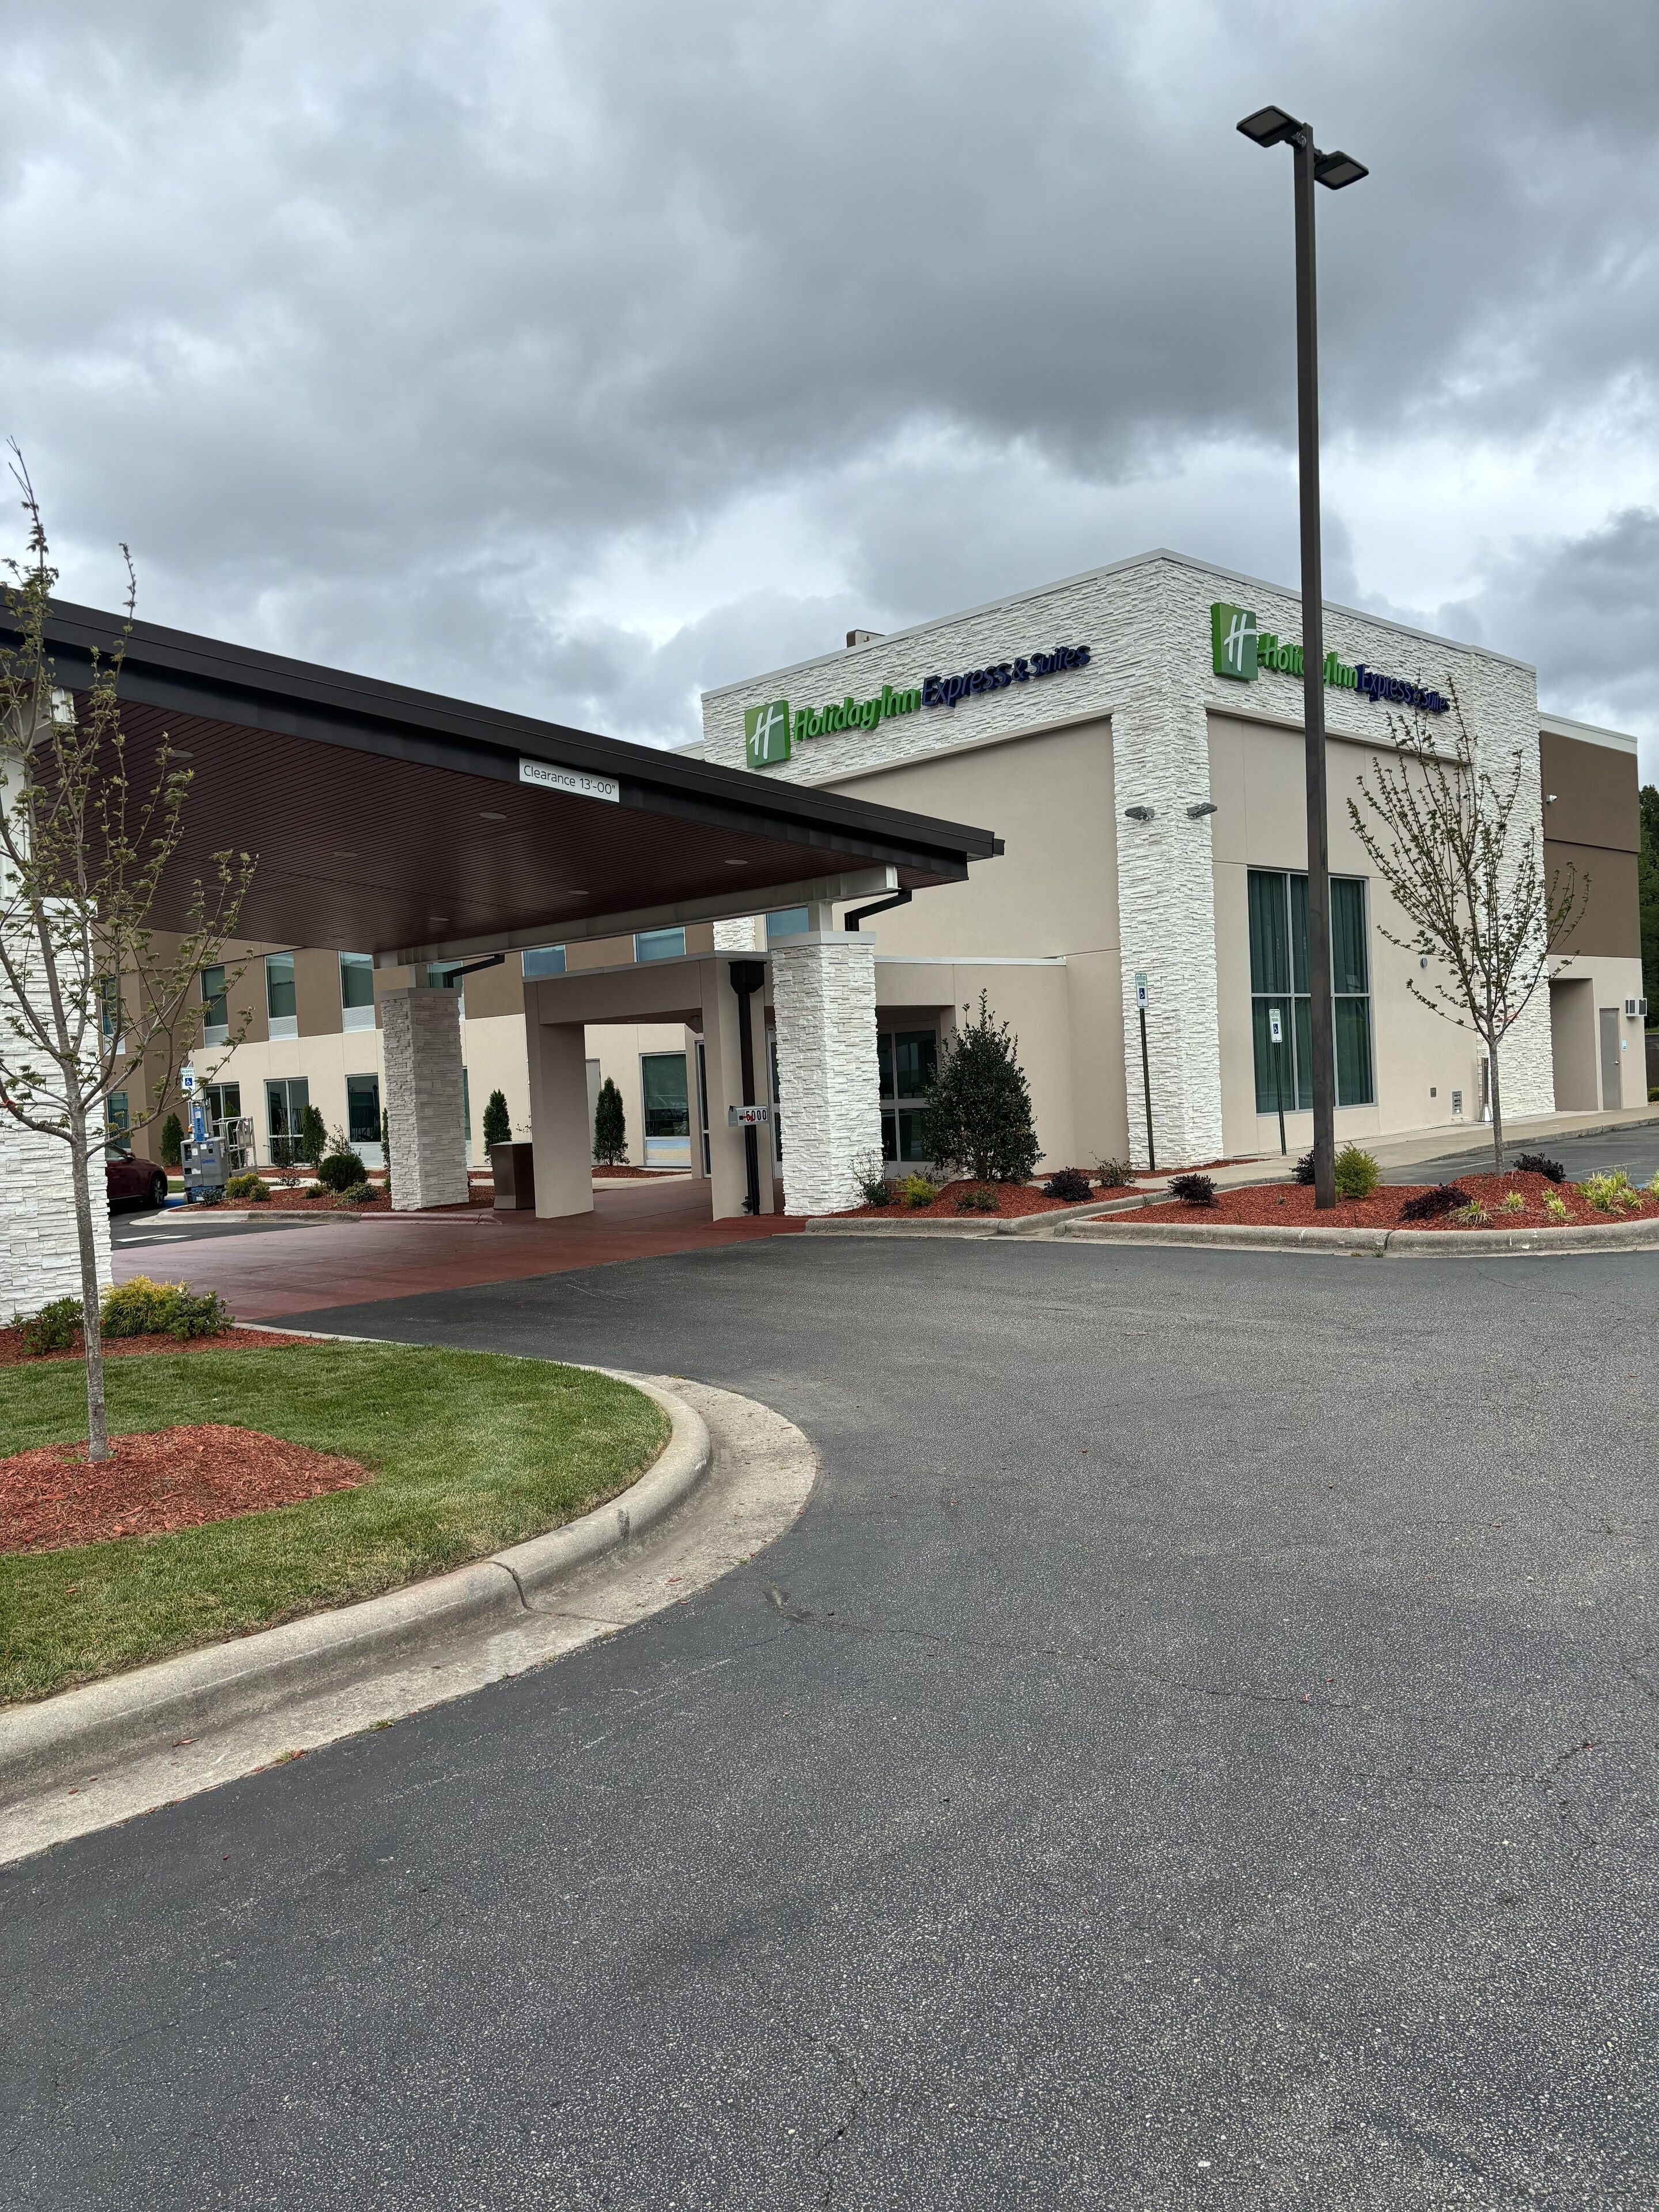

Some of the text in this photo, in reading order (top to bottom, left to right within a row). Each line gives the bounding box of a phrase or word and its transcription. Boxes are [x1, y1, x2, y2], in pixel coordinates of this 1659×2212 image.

[793, 646, 1091, 741] Holiday Inn Express & Suites
[1327, 652, 1358, 689] Inn
[1355, 664, 1411, 702] Express
[1421, 687, 1450, 713] Suites
[524, 765, 616, 794] Clearance 13'-00"
[746, 1110, 767, 1122] 5000
